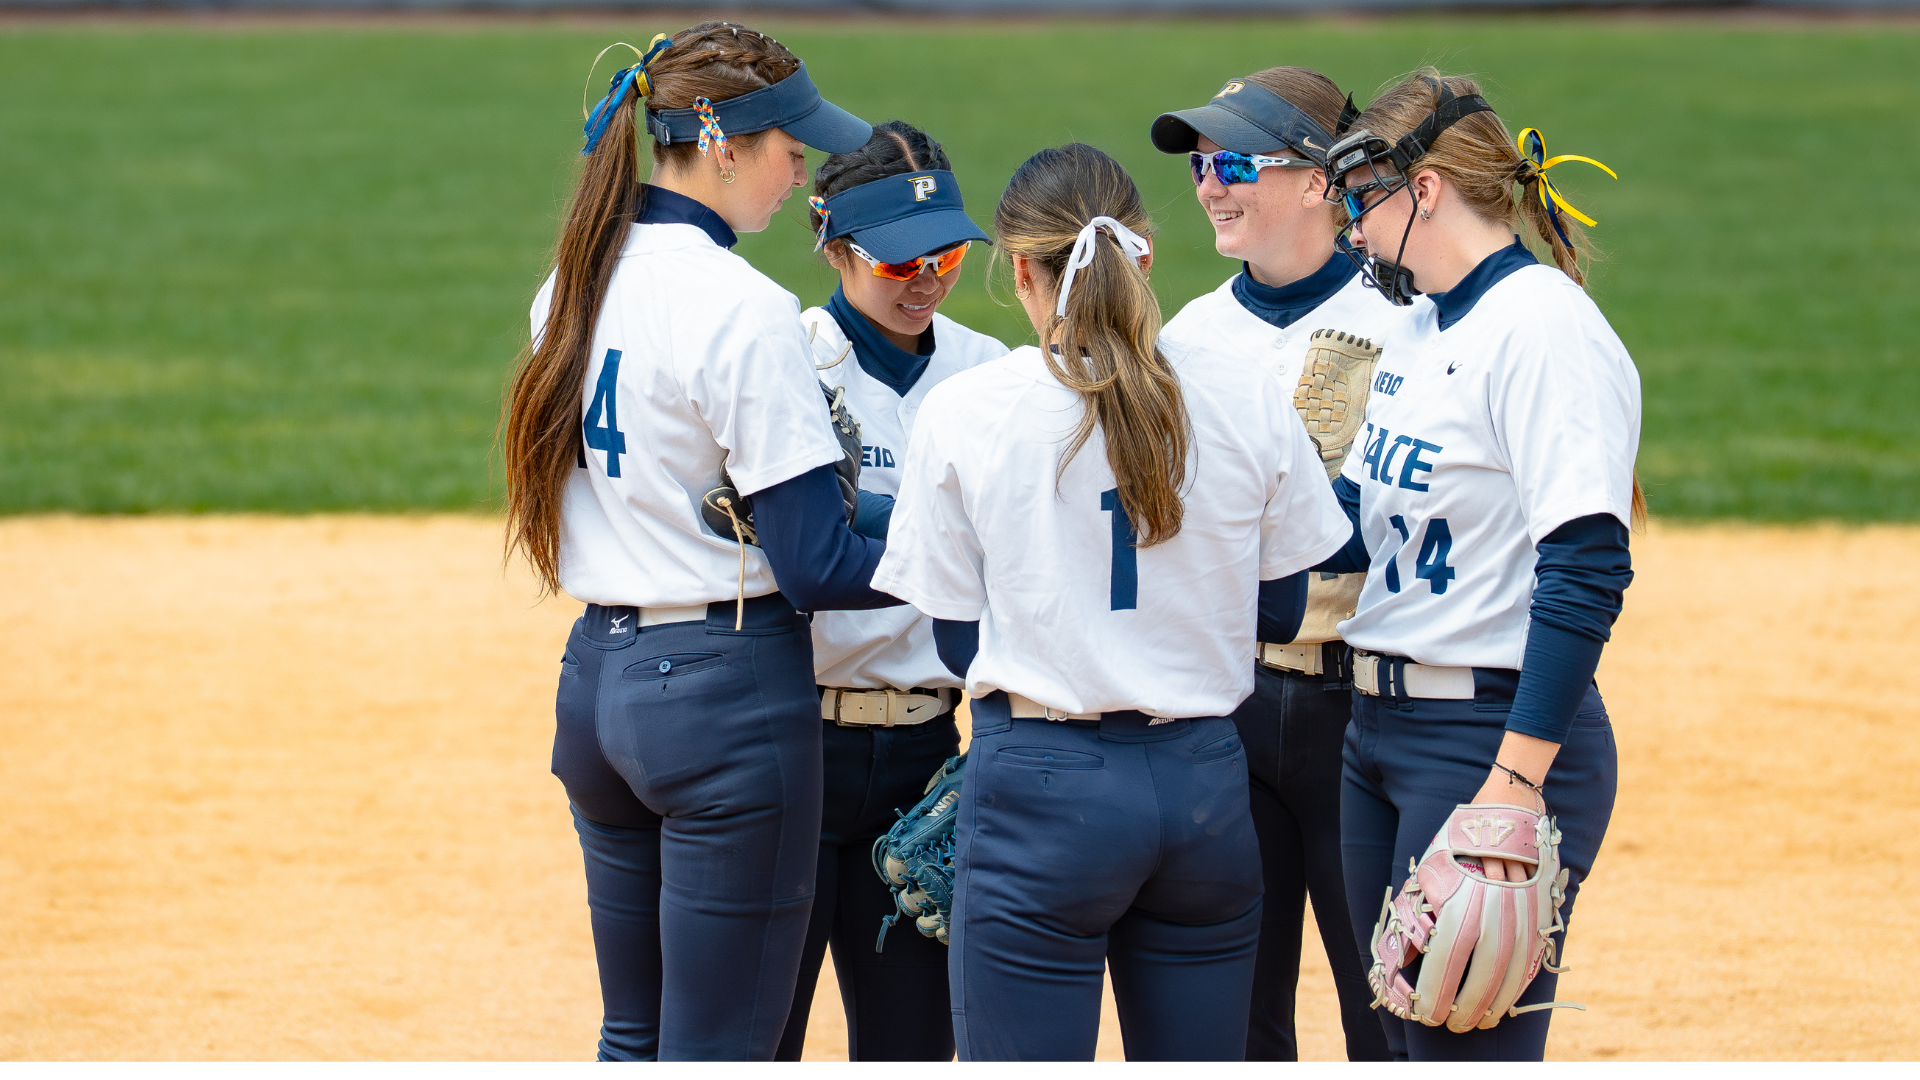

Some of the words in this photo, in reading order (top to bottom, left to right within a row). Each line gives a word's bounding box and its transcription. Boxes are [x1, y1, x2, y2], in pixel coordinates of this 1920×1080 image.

[1214, 80, 1246, 98] P
[907, 175, 937, 202] P
[577, 347, 627, 479] 4
[860, 445, 896, 469] E10
[1100, 486, 1139, 612] 1
[1385, 513, 1456, 596] 14
[925, 790, 960, 817] LUNA
